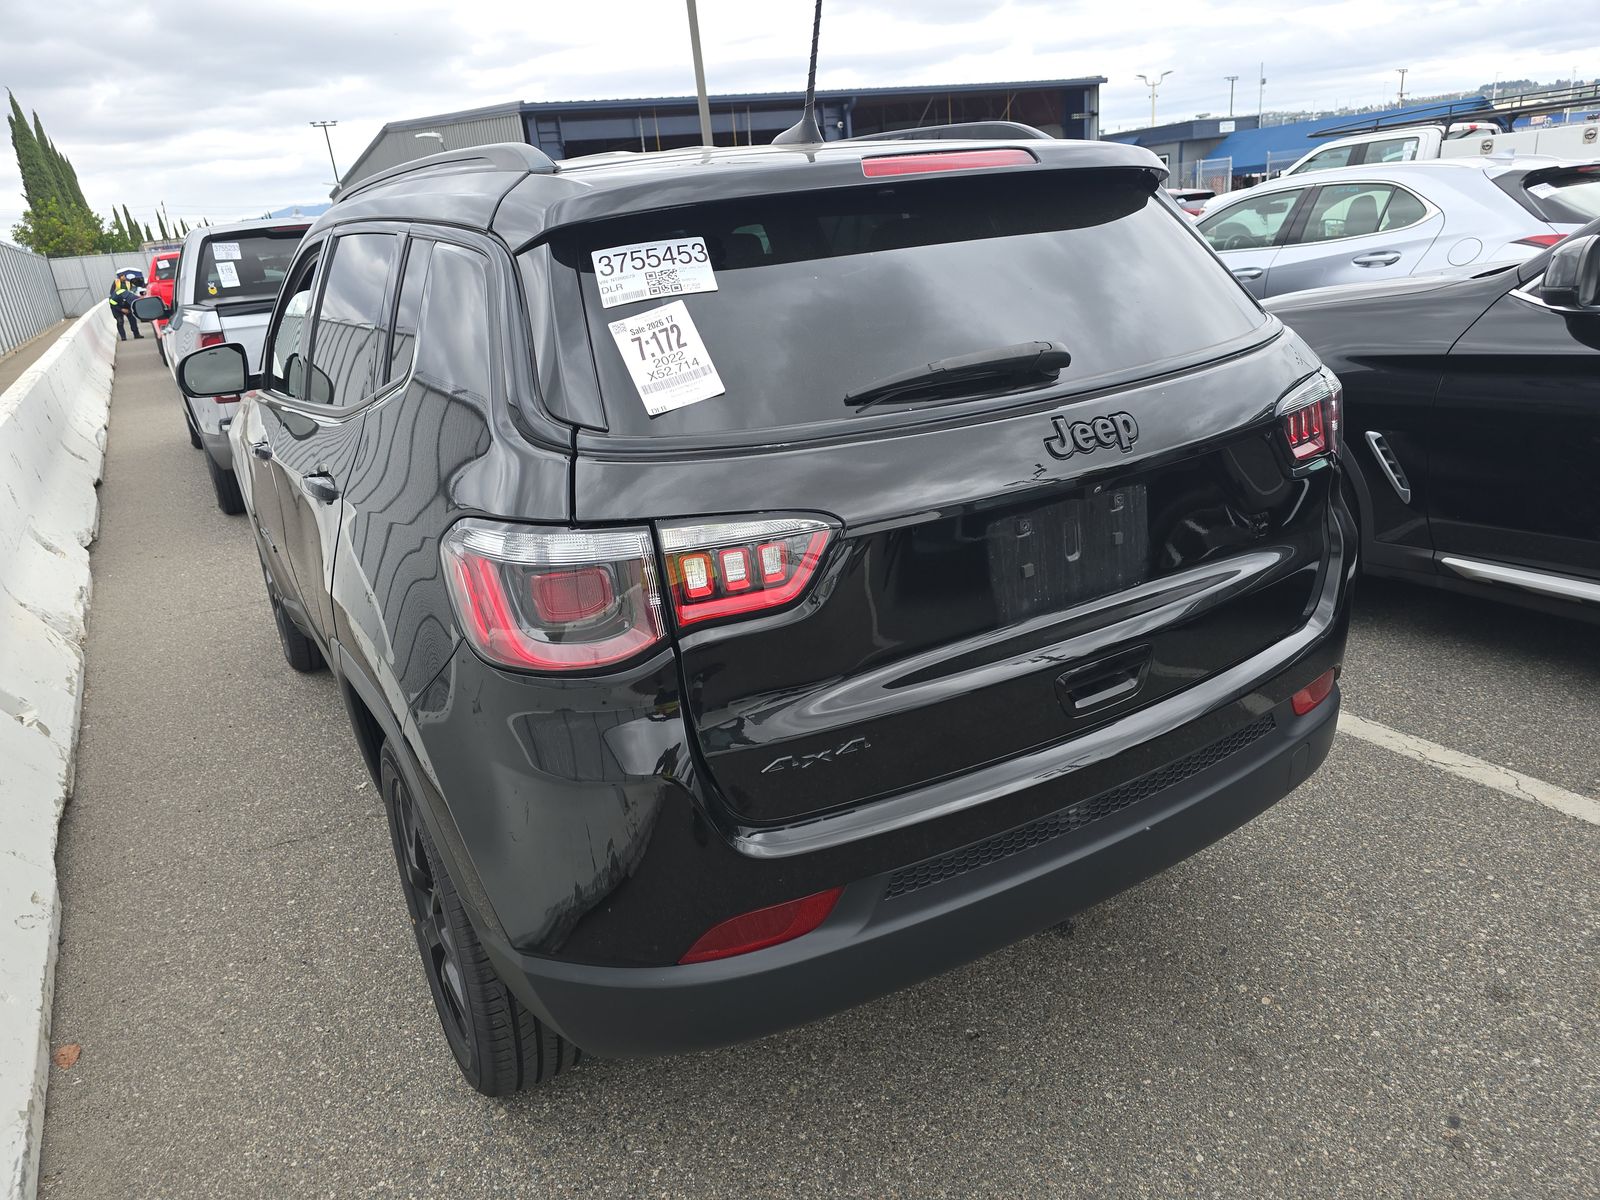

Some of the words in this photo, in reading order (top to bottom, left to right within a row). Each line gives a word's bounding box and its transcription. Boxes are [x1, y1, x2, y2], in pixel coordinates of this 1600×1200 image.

[598, 242, 709, 277] 3755453
[601, 283, 624, 295] DLR
[630, 326, 646, 336] Sale
[646, 319, 664, 331] 2026
[665, 315, 674, 324] 17
[630, 323, 688, 361] 7:172
[647, 357, 700, 381] X52,714
[653, 350, 686, 369] 2022
[1043, 411, 1139, 460] Jeep
